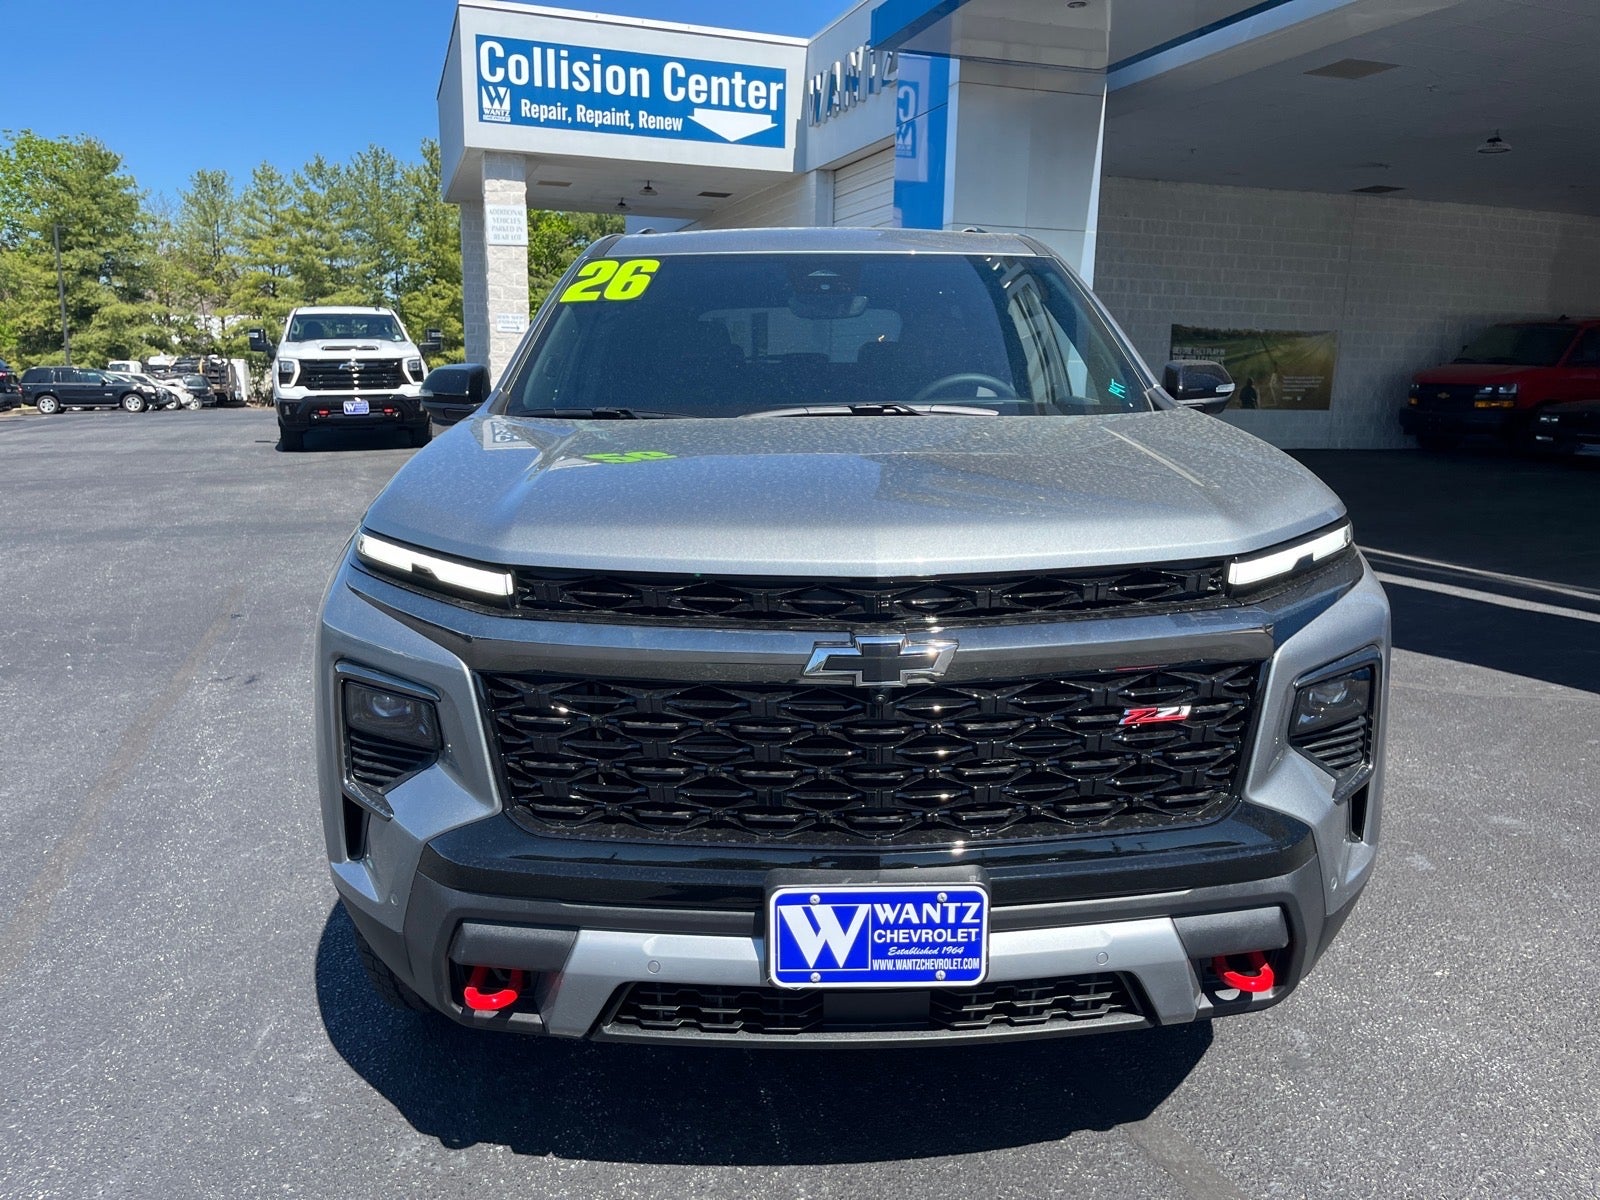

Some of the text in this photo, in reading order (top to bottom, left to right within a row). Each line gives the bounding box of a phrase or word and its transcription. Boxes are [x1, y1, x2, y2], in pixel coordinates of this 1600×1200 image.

[479, 40, 784, 111] Collision Center
[521, 98, 683, 132] Repair, Repaint, Renew
[560, 259, 660, 303] 26
[1119, 705, 1191, 725] Z71
[873, 902, 981, 925] WANTZ
[779, 905, 870, 969] W
[873, 928, 980, 944] CHEVROLET
[887, 945, 965, 956] Established 1964
[872, 957, 980, 971] WWW.WANTZCHEVROLET.COM
